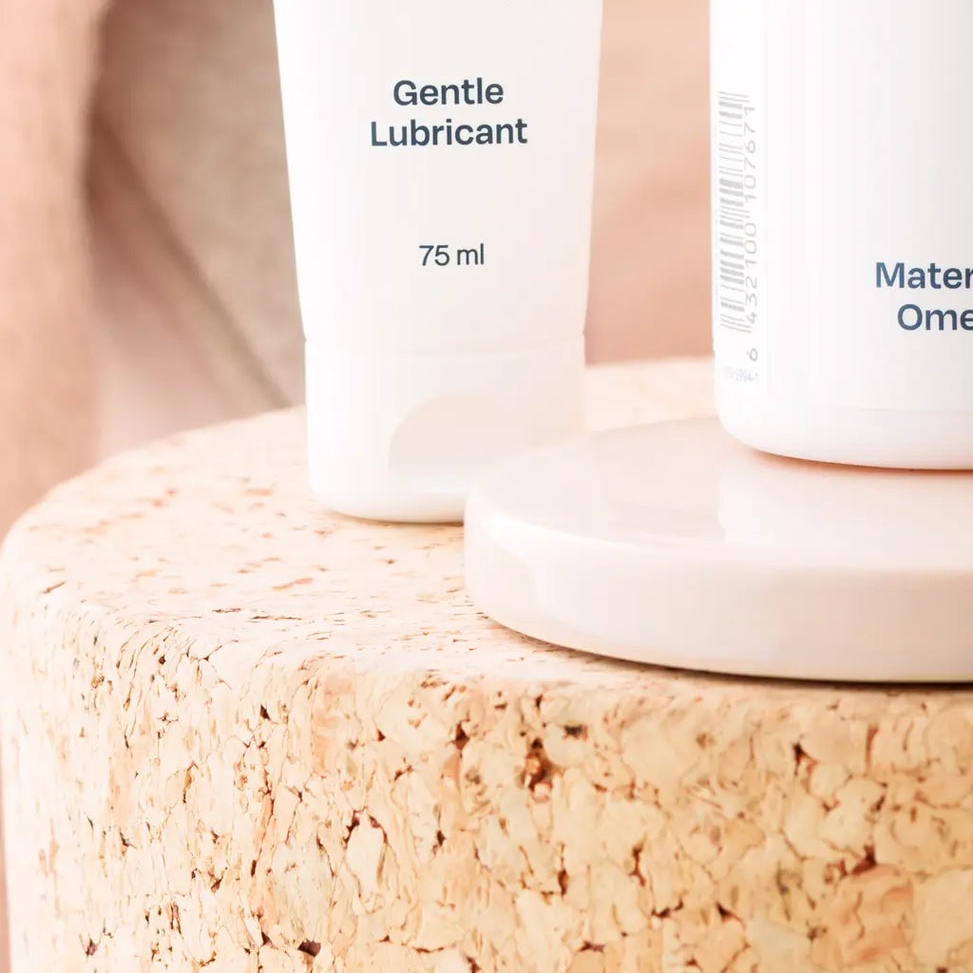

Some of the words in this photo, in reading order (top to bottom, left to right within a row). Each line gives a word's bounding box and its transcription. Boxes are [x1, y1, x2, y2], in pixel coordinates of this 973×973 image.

[392, 77, 505, 107] Gentle
[370, 117, 529, 147] Lubricant
[419, 245, 451, 267] 75
[456, 243, 486, 265] ml
